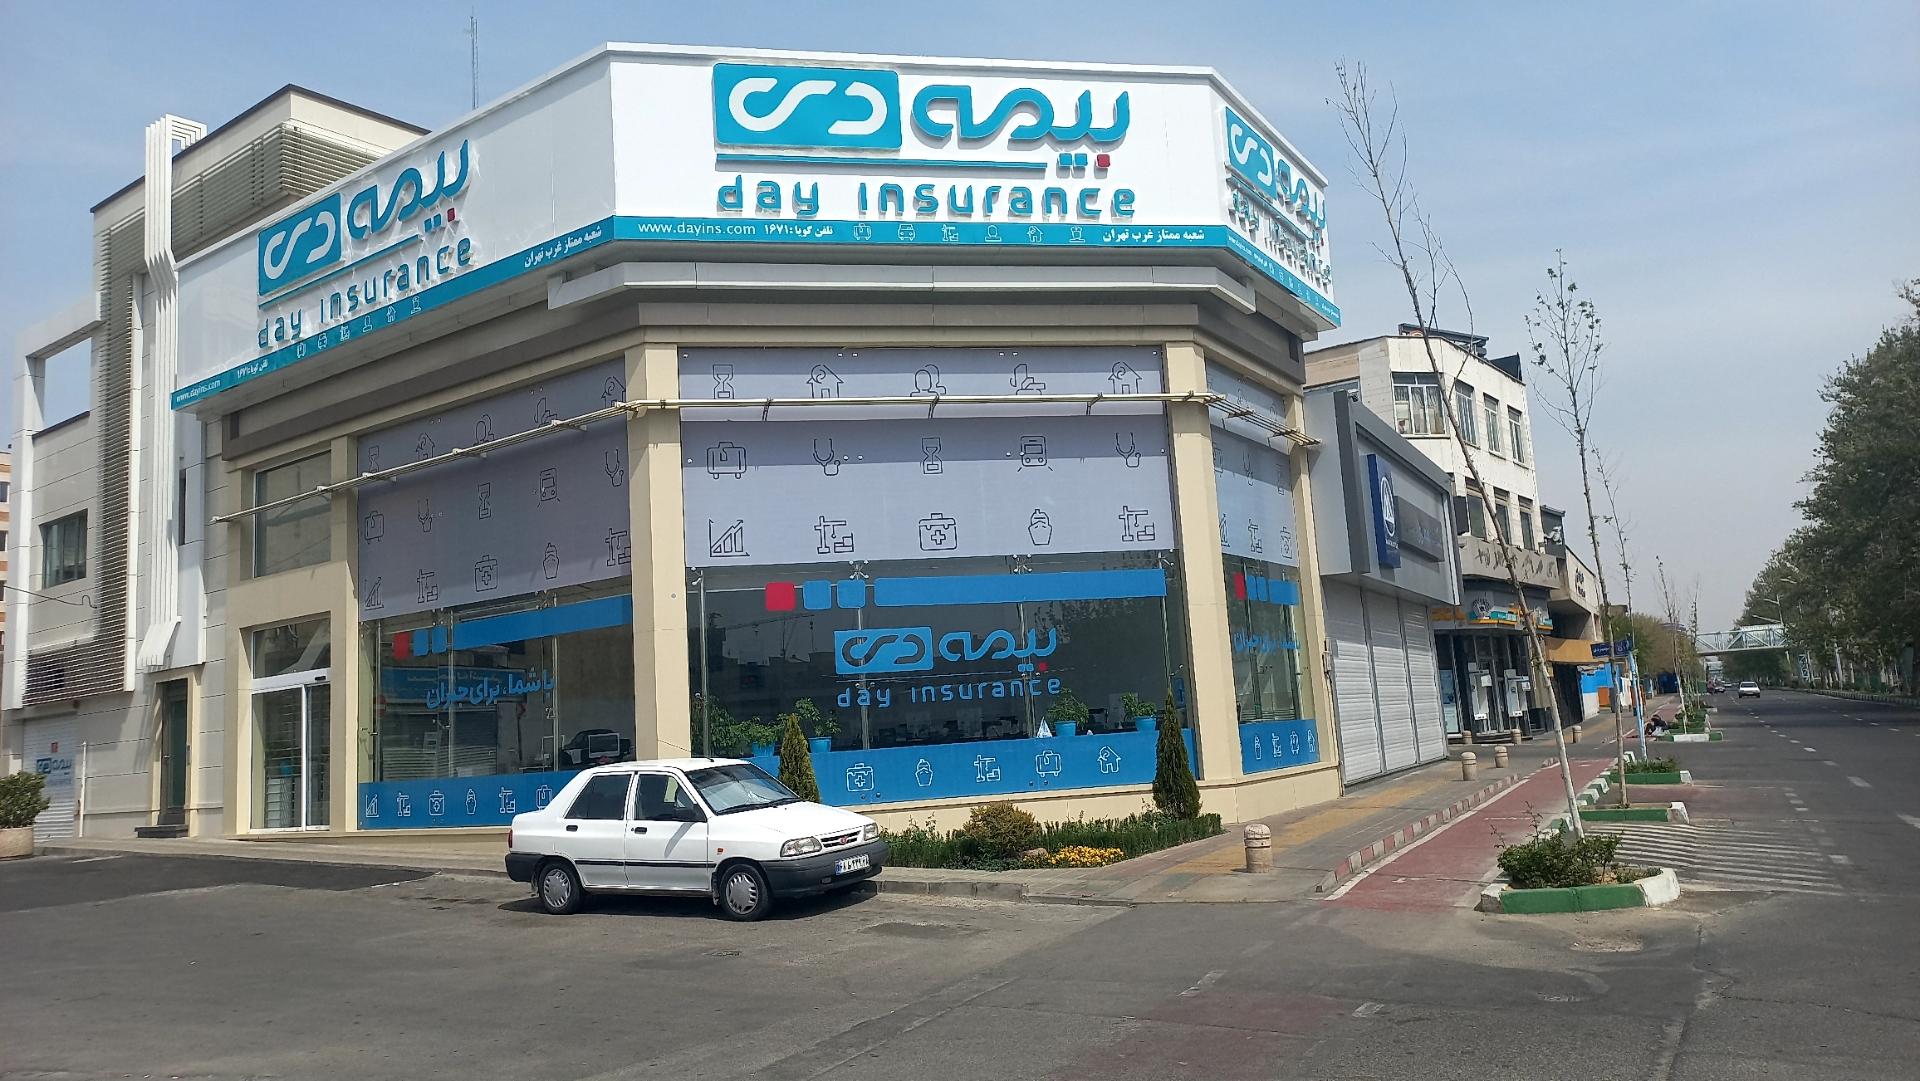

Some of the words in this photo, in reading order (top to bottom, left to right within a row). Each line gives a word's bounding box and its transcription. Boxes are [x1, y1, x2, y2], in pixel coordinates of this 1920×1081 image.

[727, 76, 889, 137] دی
[912, 84, 1131, 168] بیمه
[346, 138, 470, 241] بیمه
[716, 174, 820, 216] day
[583, 225, 602, 243] شعبه
[637, 221, 756, 236] www.dayins.com
[1102, 227, 1129, 242] تهران
[1131, 228, 1154, 243] غرب
[1156, 228, 1181, 243] ممتاز
[1182, 228, 1205, 243] شعبه
[563, 235, 583, 254] ممتاز
[524, 247, 544, 268] تهران
[257, 308, 302, 349] day
[938, 627, 1058, 672] بیمه
[836, 685, 891, 709] day
